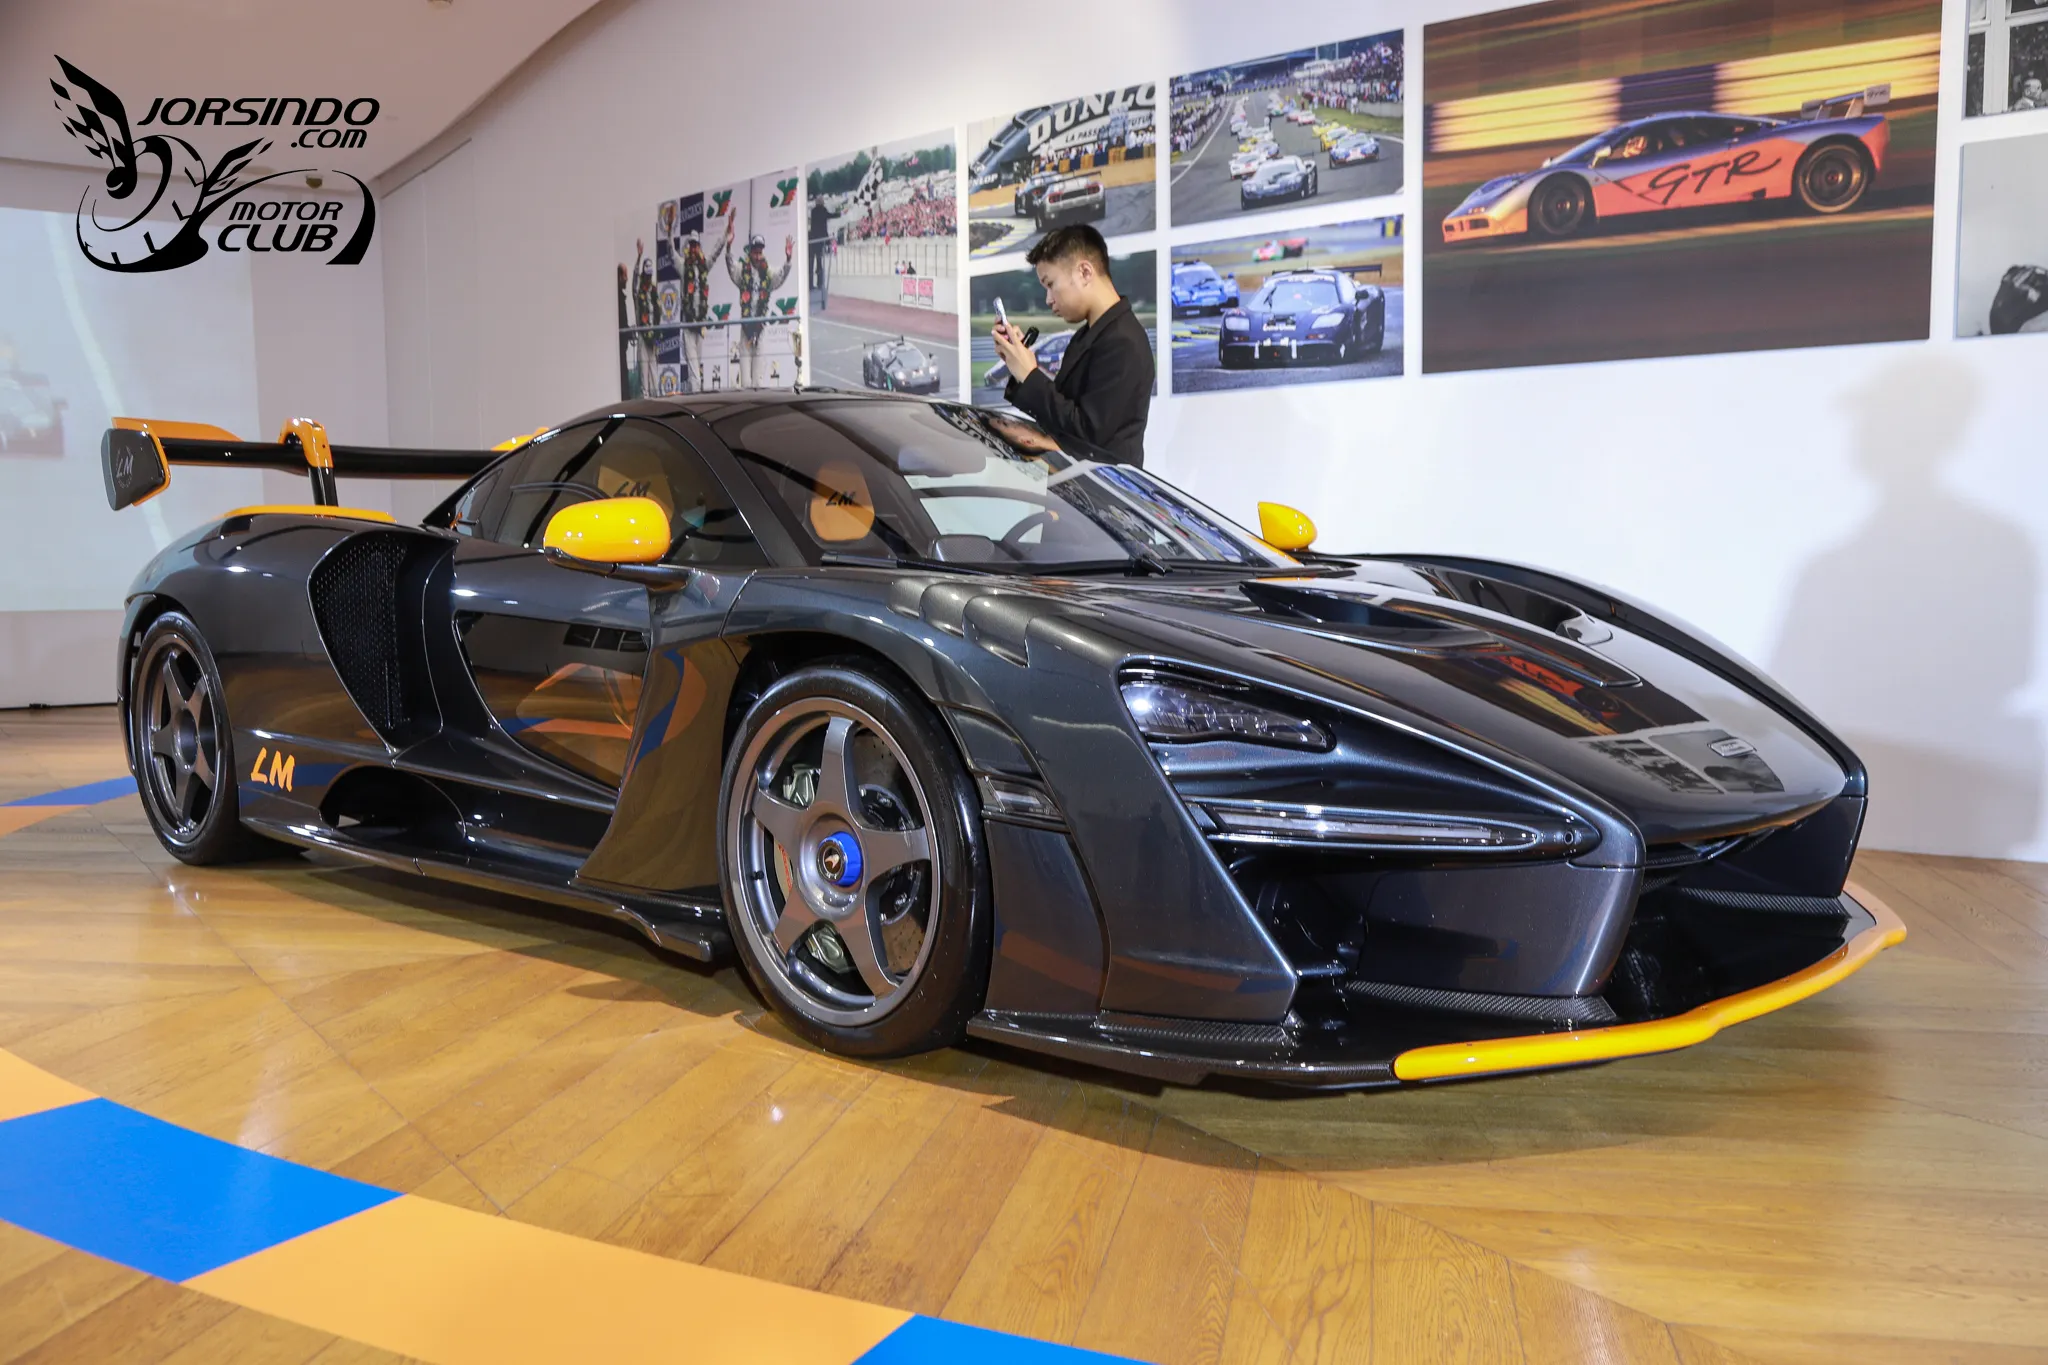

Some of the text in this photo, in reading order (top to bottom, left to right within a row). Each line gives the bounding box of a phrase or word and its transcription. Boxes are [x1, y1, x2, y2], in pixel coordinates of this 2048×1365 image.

[1649, 151, 1782, 205] GTR
[613, 481, 651, 497] LM
[825, 491, 855, 506] LM
[251, 747, 296, 792] LM
